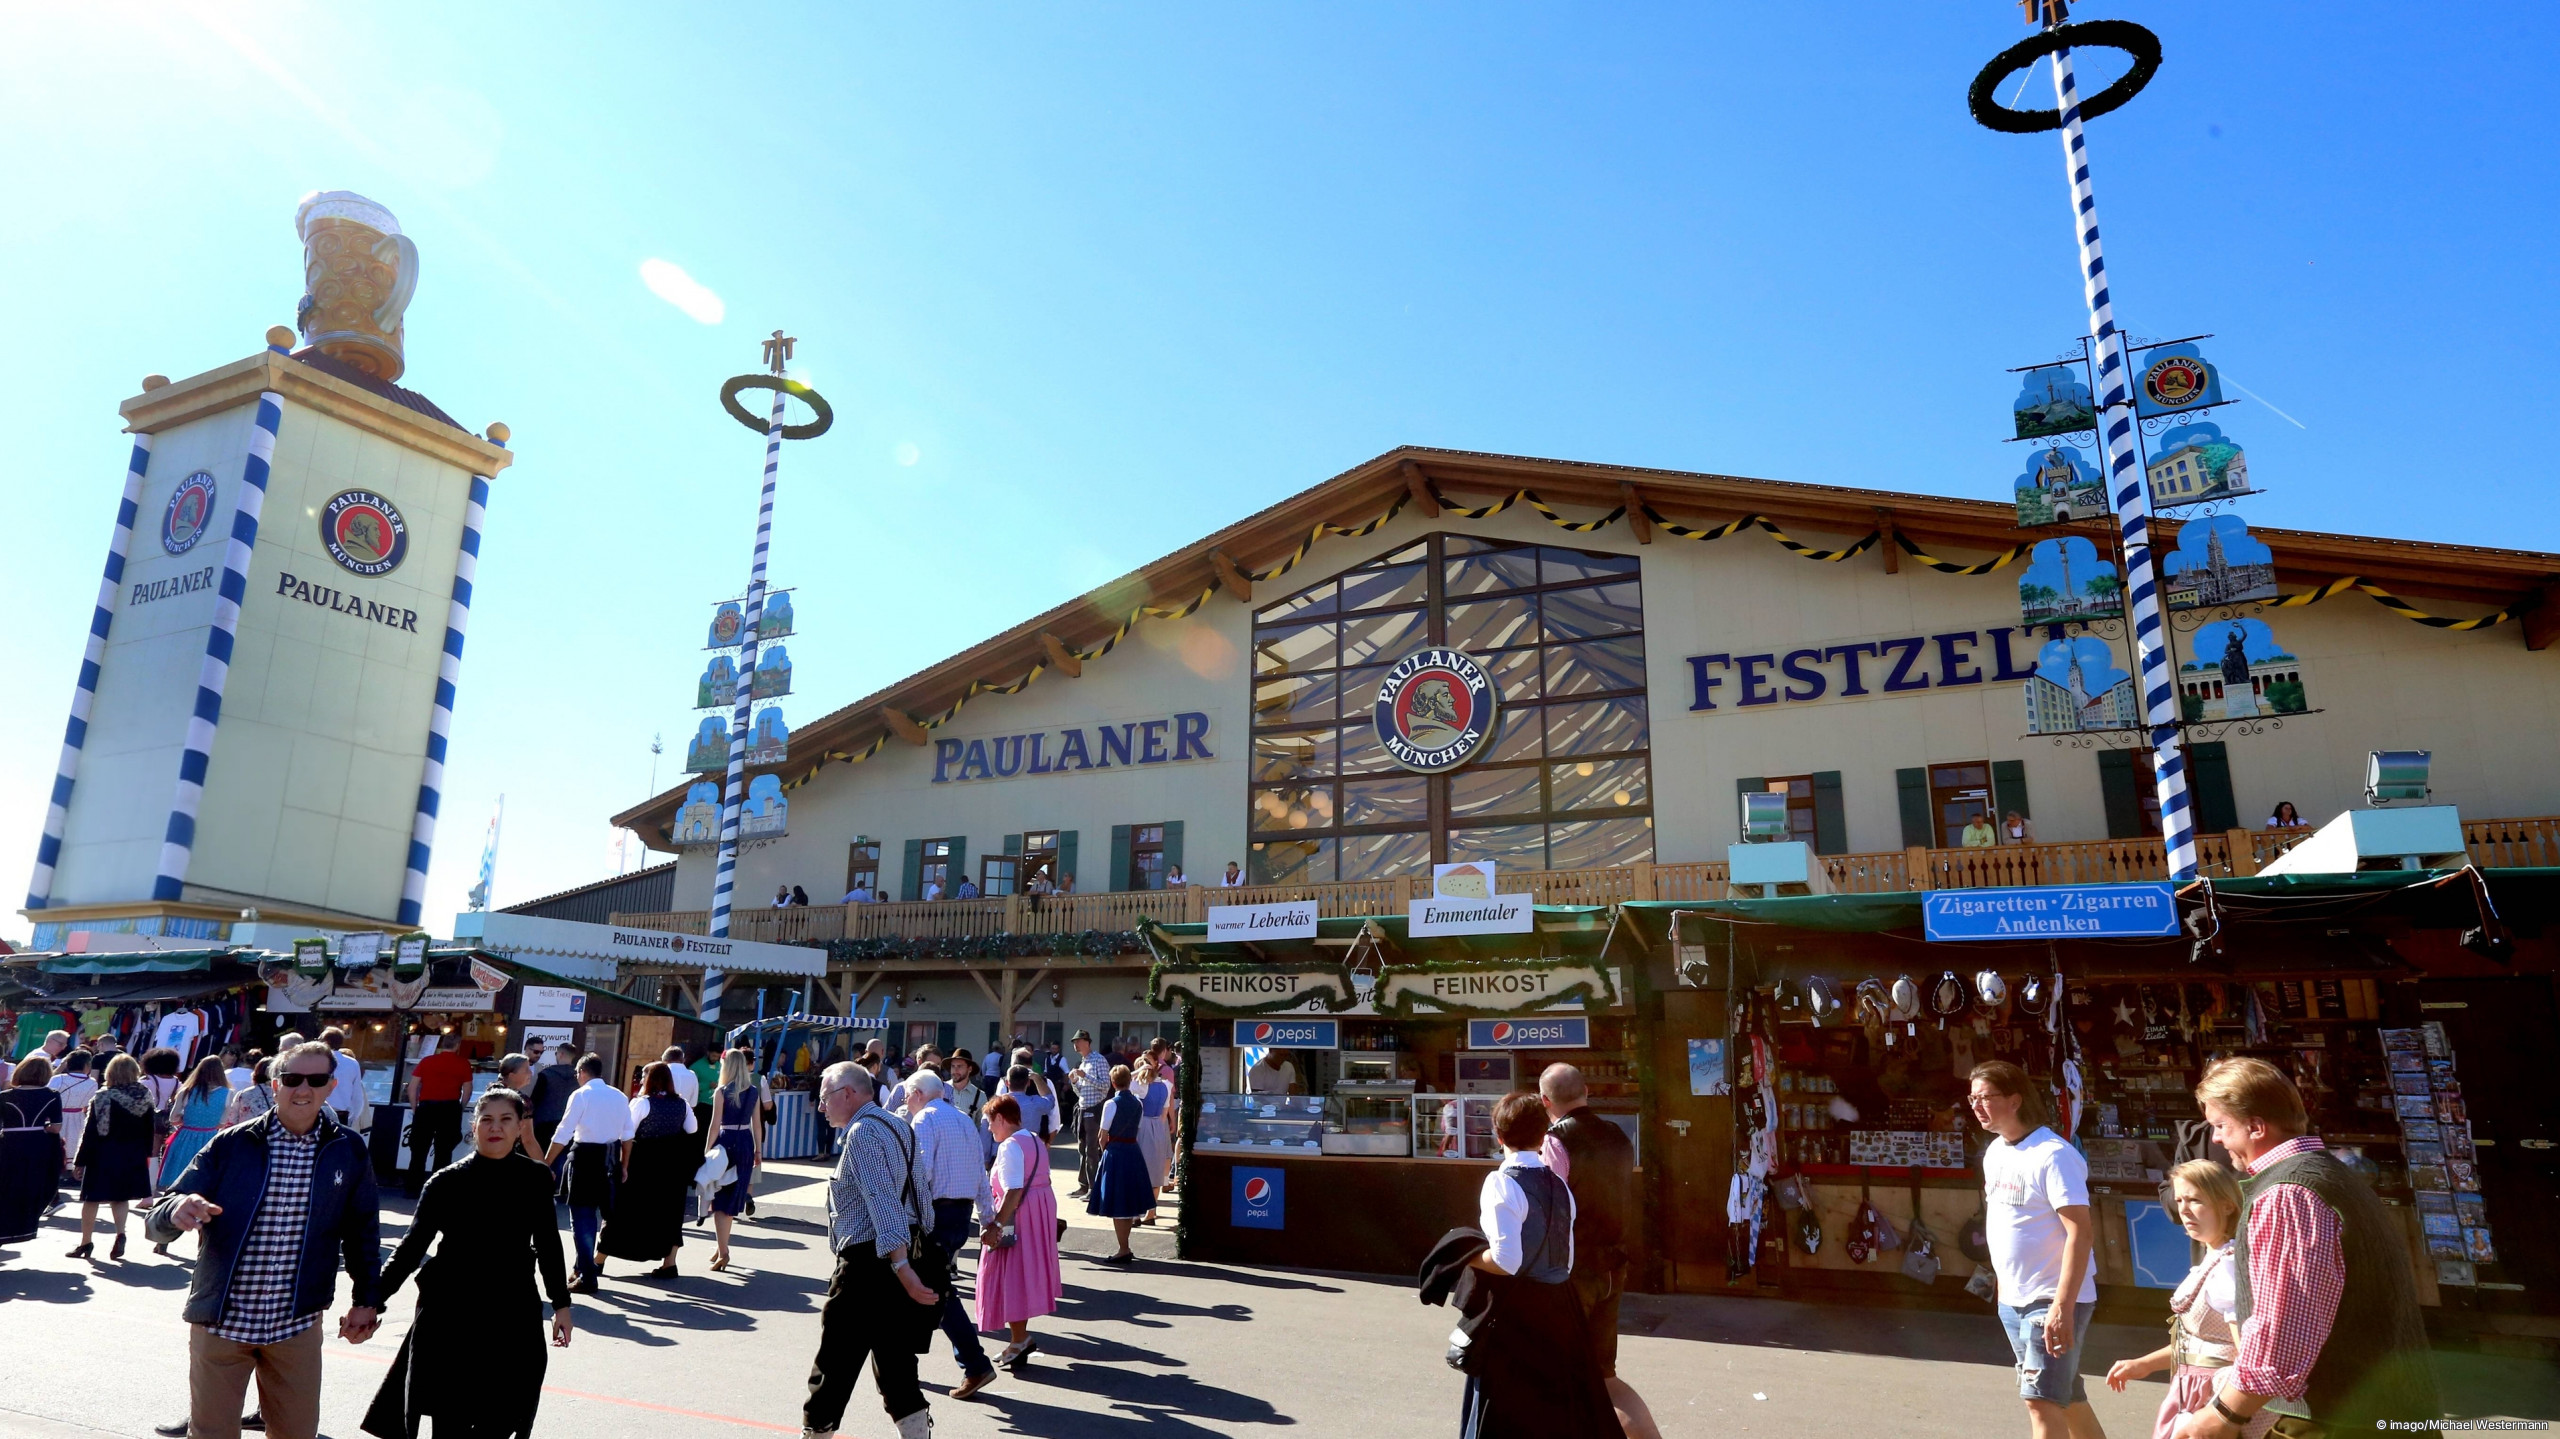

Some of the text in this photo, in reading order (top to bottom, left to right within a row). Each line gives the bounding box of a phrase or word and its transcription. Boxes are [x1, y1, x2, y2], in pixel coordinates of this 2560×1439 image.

[2148, 359, 2202, 382] PAULANER
[169, 472, 215, 508] PAULANER
[328, 492, 404, 535] PAULANER
[328, 542, 393, 574] MÜNCHEN
[129, 565, 215, 606] PAULANER
[276, 571, 419, 634] PAULANER
[1377, 650, 1487, 705] PAULANER
[931, 711, 1215, 783] PAULANER
[1385, 728, 1480, 766] MÜNCHEN
[1424, 903, 1519, 924] Emmentaler
[1938, 893, 2159, 917] Zigaretten Zigarren
[1214, 910, 1310, 930] warmer Leberkäs
[1995, 914, 2101, 933] Andenken
[613, 932, 669, 949] PAULANER
[686, 940, 732, 955] FESTZELT
[1200, 976, 1299, 993] FEINKOST
[1434, 974, 1549, 995] FEINKOST
[1276, 1026, 1317, 1043] pepsi
[1518, 1024, 1563, 1042] pepsi
[1247, 1208, 1268, 1217] pepsi
